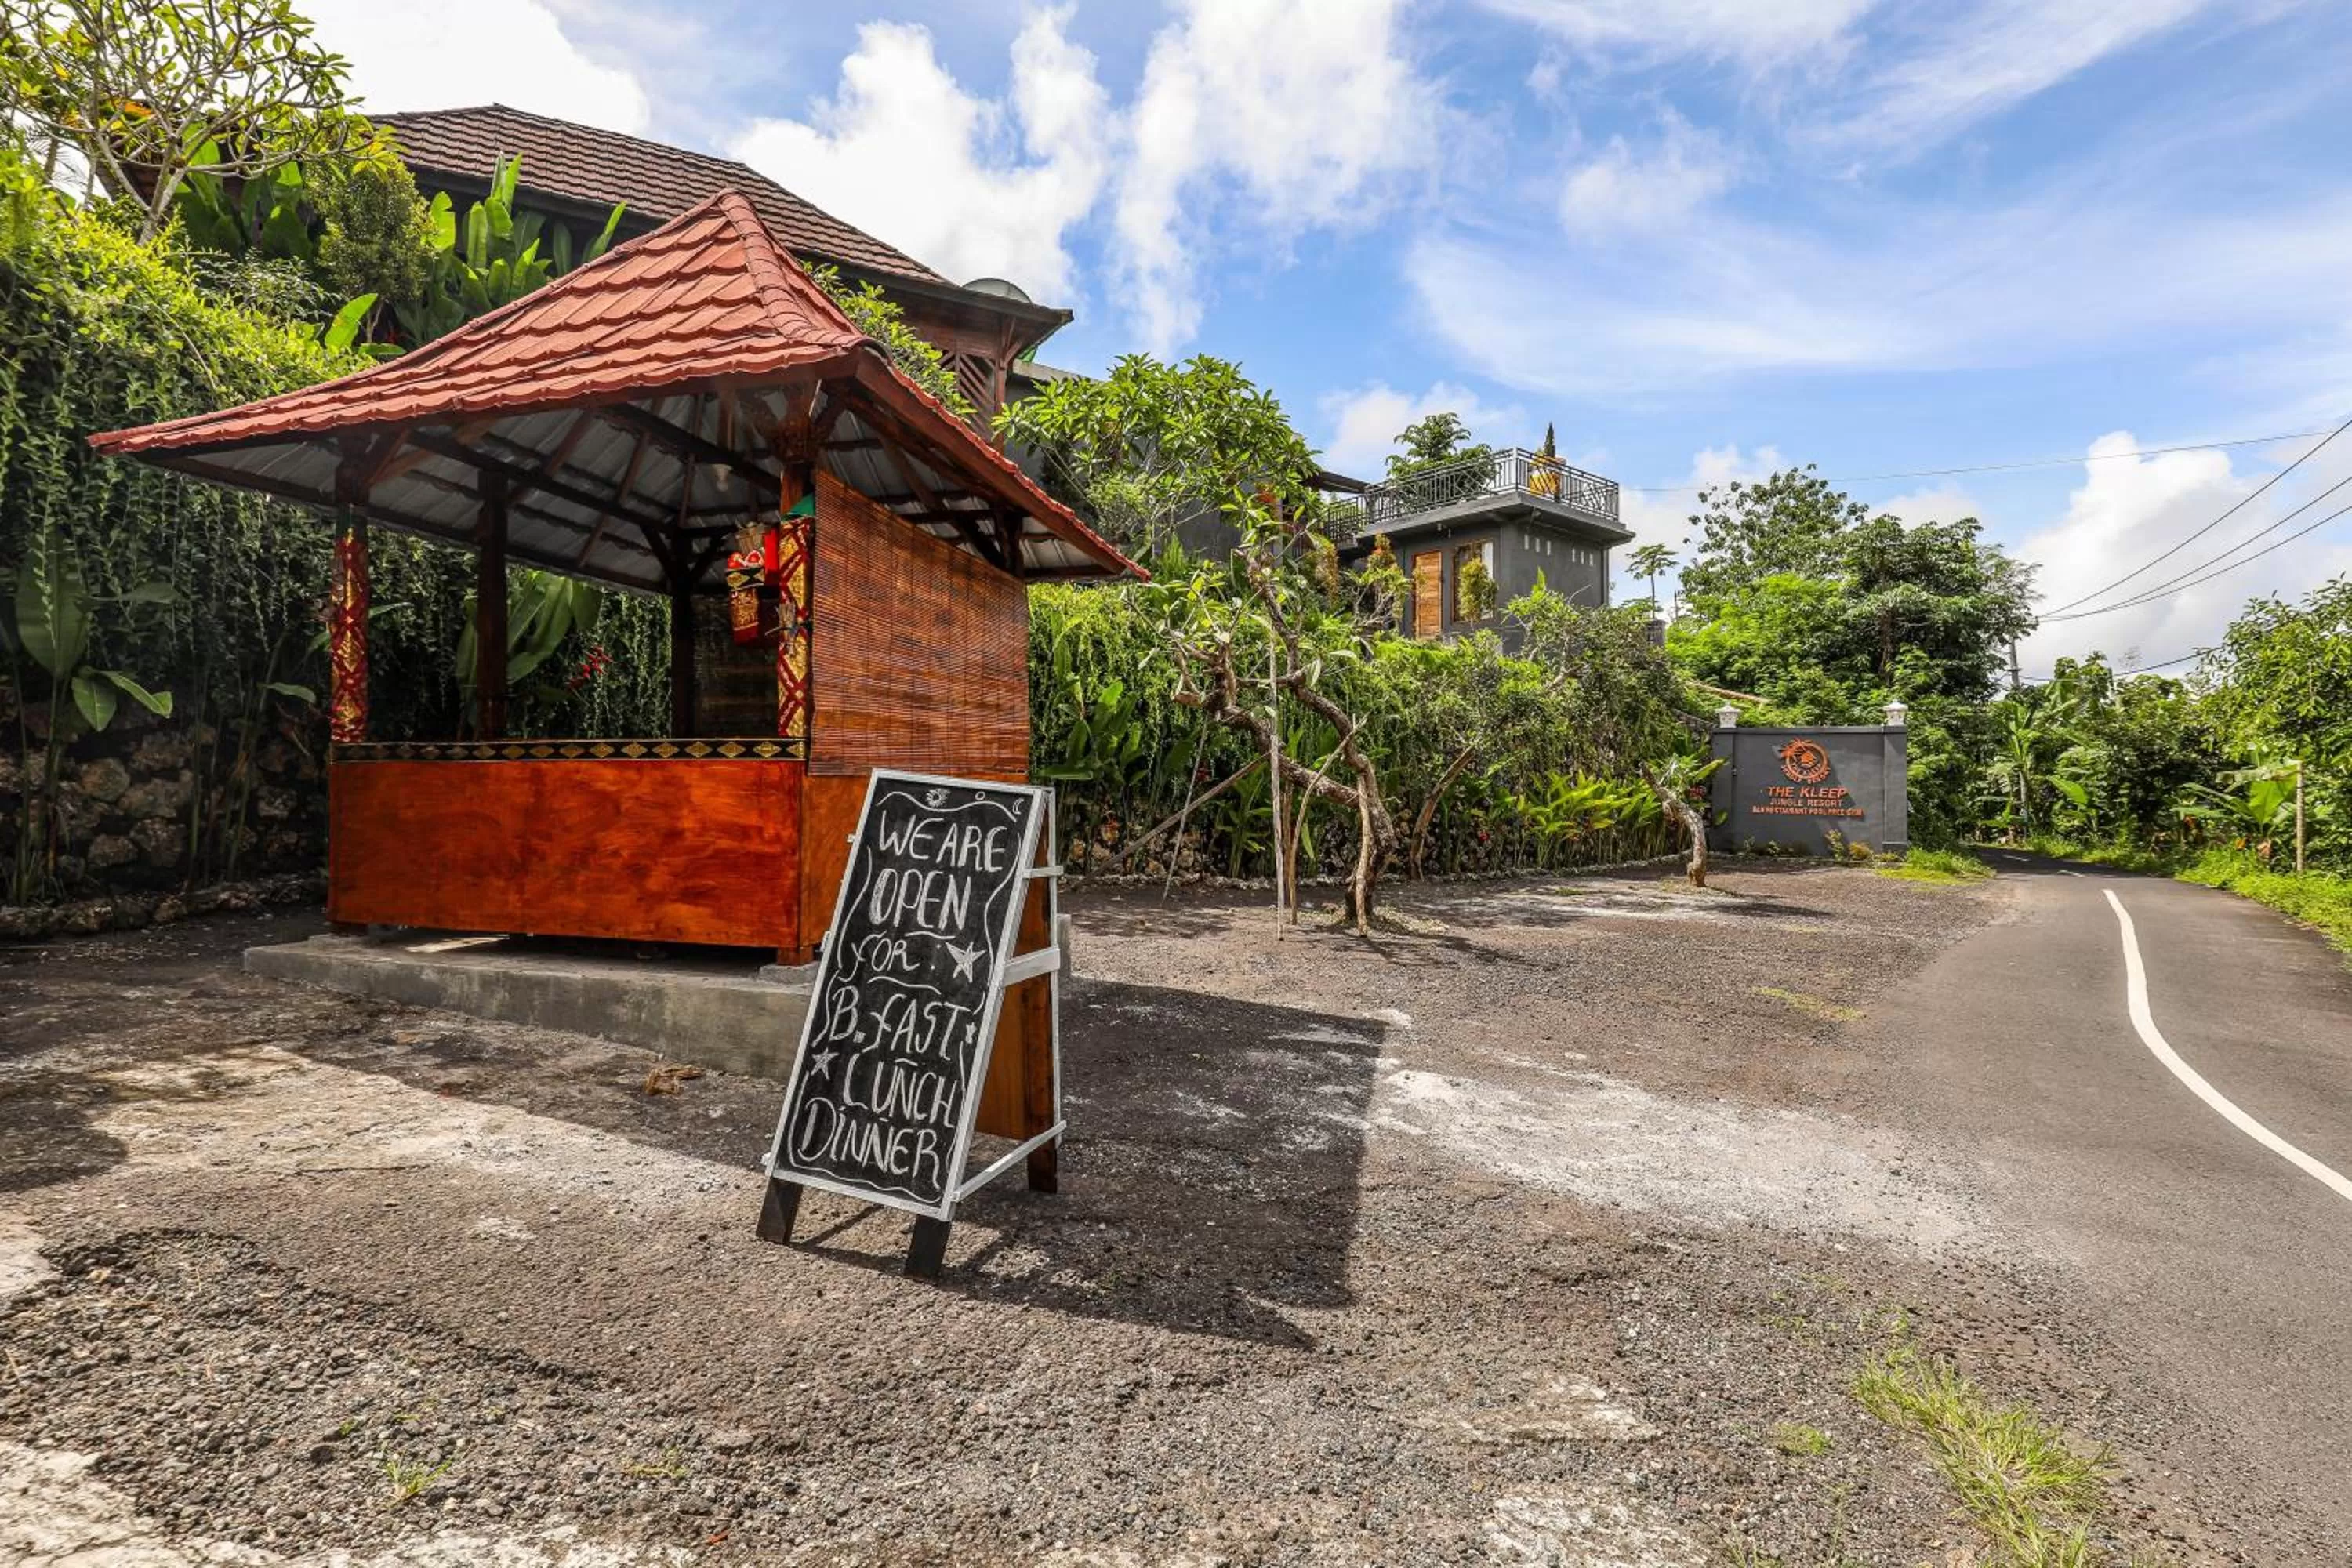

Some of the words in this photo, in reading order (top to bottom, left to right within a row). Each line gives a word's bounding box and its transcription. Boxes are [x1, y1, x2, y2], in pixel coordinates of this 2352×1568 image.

[1768, 786, 1794, 797] THE
[1799, 786, 1846, 798] KLEEP
[1807, 799, 1843, 808] RESORT
[879, 810, 944, 859] WE
[935, 823, 1007, 872] ARE
[869, 869, 971, 931] OPEN
[843, 1054, 956, 1127] LUNCH
